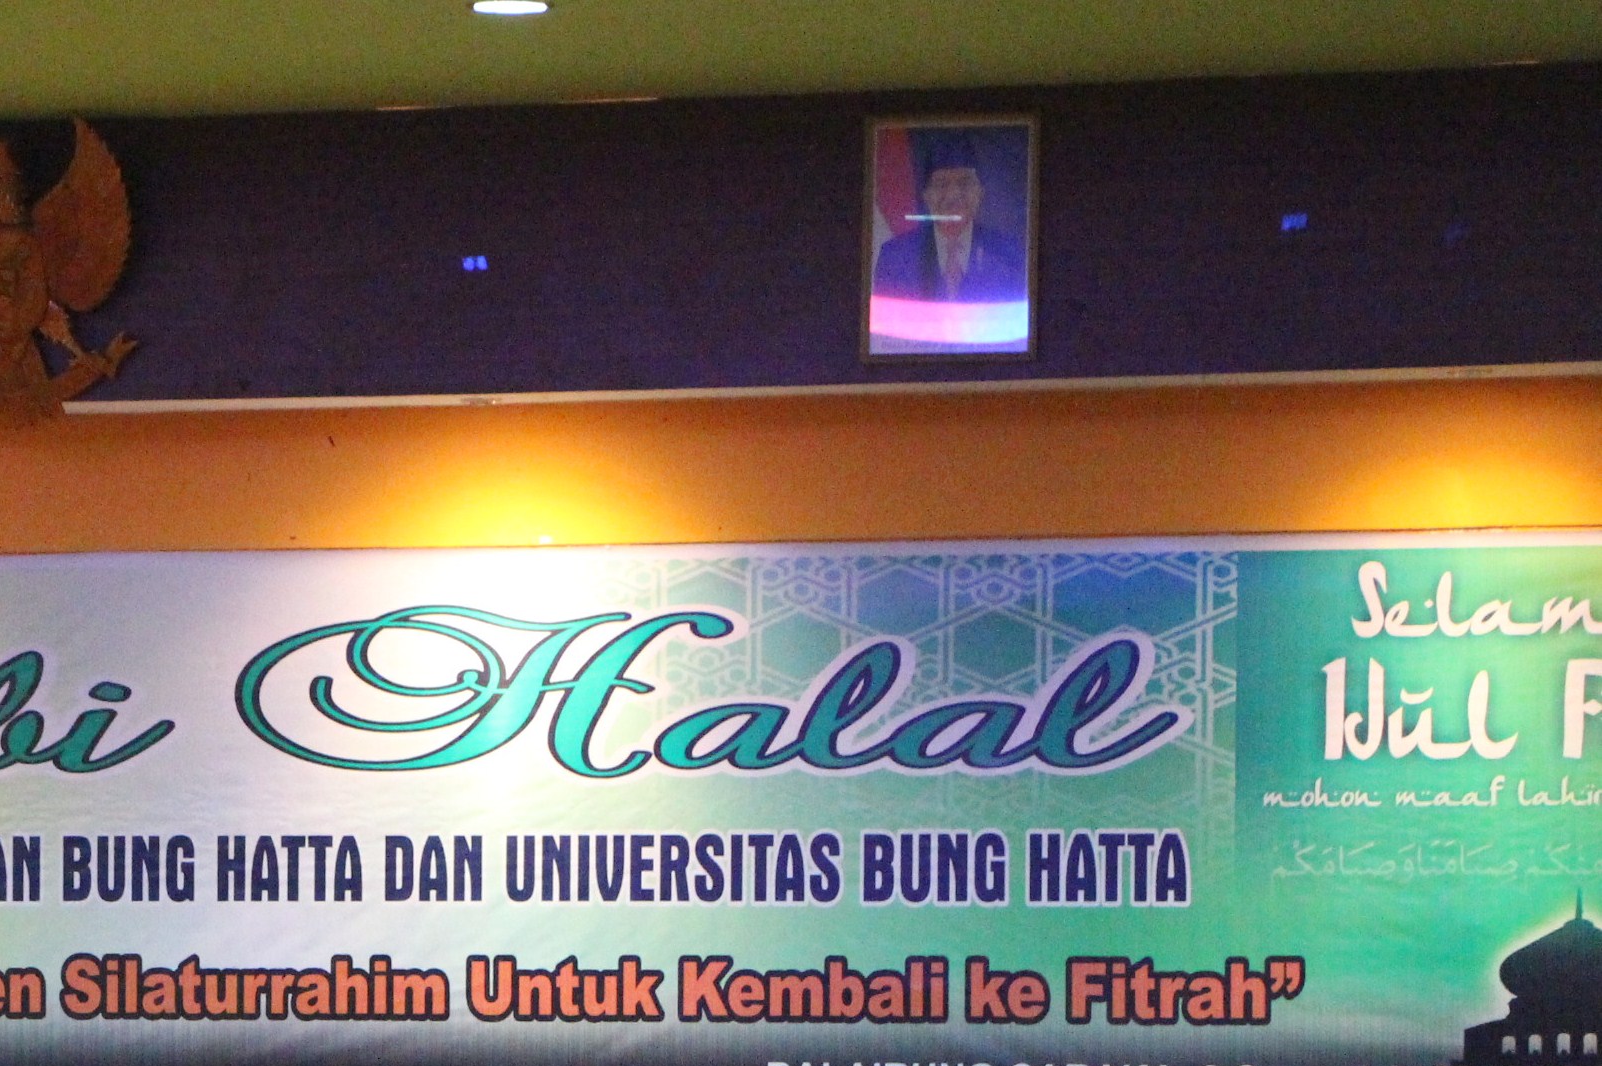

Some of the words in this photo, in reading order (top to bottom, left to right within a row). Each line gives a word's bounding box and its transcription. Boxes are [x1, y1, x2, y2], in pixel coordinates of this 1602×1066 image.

[1352, 561, 1602, 637] Selam
[234, 605, 1178, 778] Halal
[1263, 777, 1382, 807] mohon
[1396, 775, 1506, 807] maaf
[62, 835, 196, 902] BUNG
[217, 835, 363, 902] HATTA
[384, 835, 483, 902] DAN
[506, 833, 841, 902] UNIVERSITAS
[862, 833, 1006, 902] BUNG
[1029, 833, 1188, 902] HATTA
[60, 953, 450, 1020] Silaturrahim
[466, 955, 665, 1022] Untuk
[677, 955, 950, 1023] Kembali
[964, 955, 1051, 1024] ke
[1064, 955, 1306, 1026] Fitrah”
